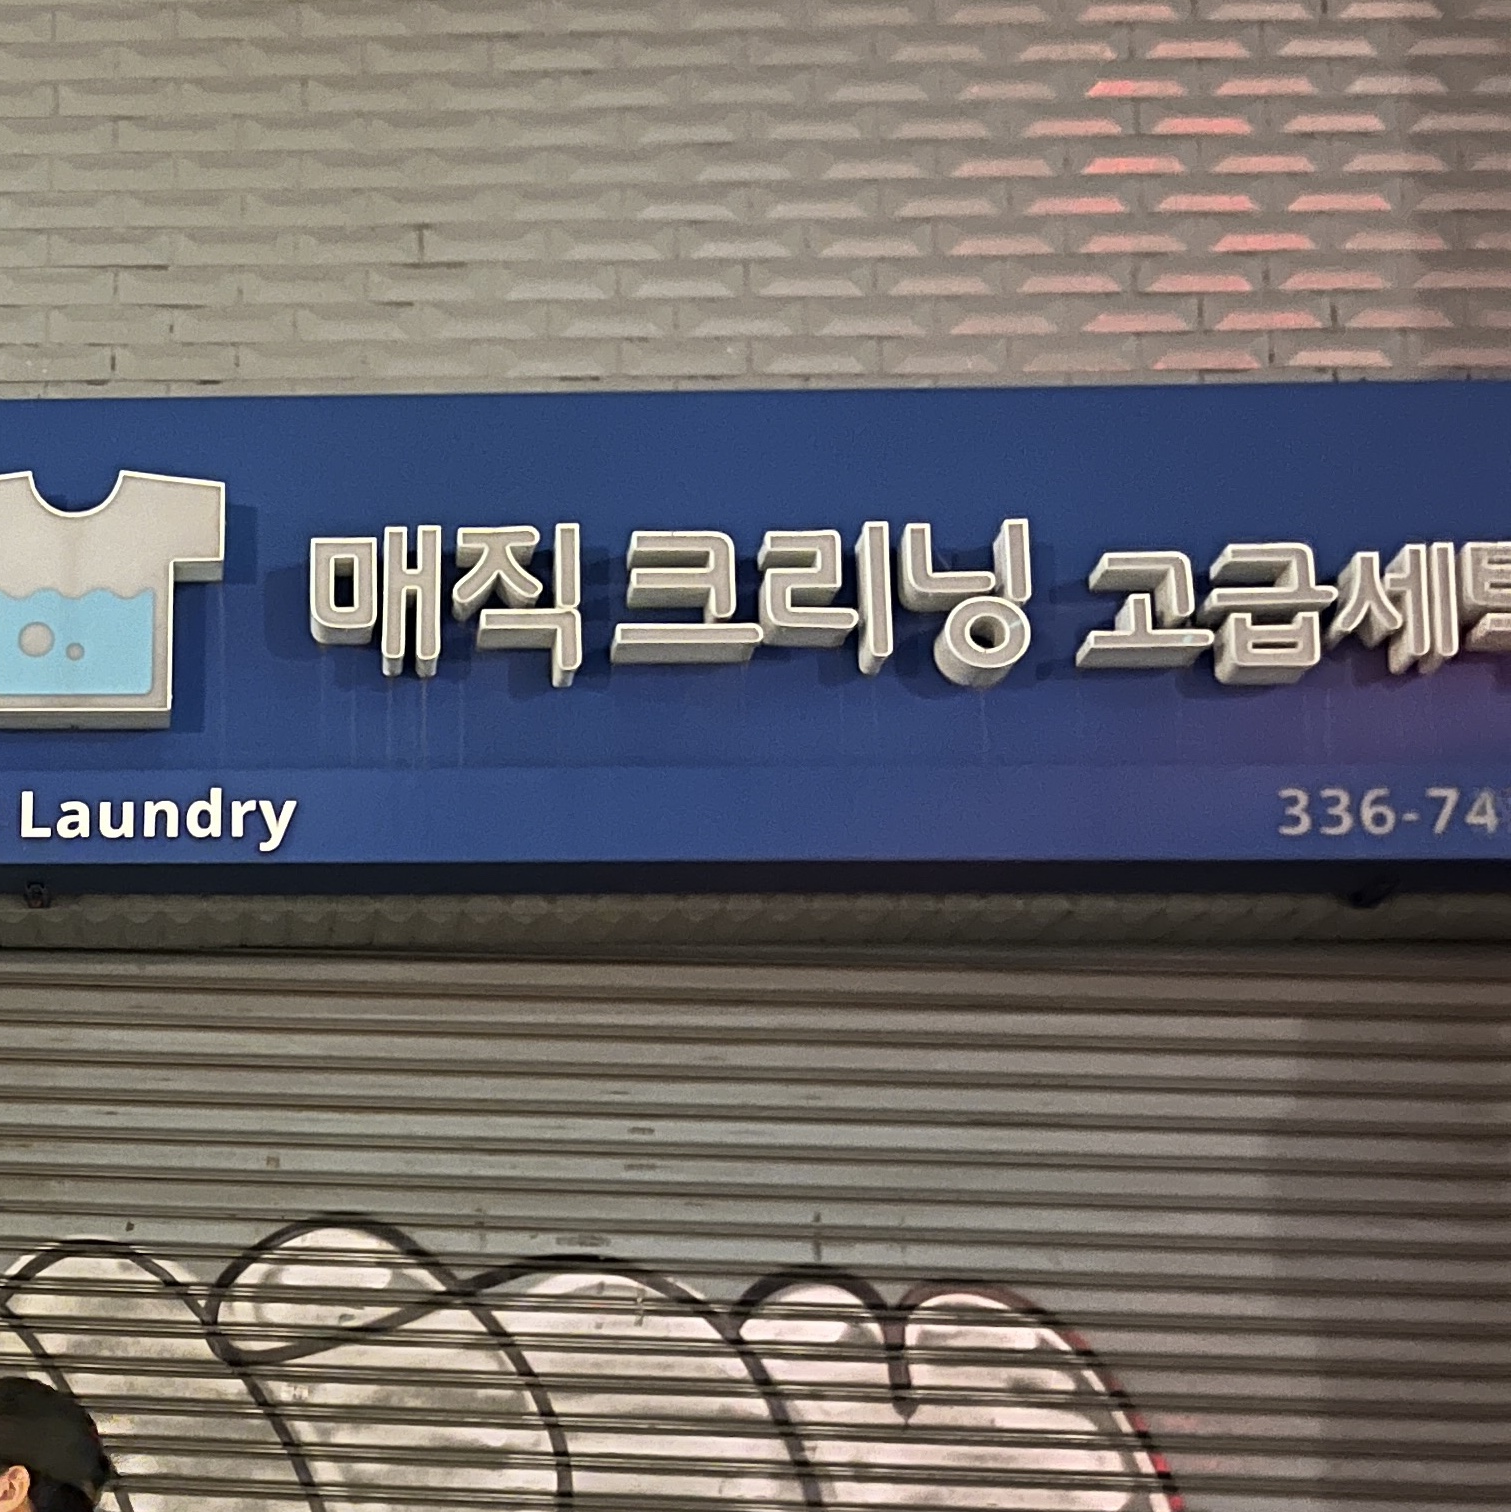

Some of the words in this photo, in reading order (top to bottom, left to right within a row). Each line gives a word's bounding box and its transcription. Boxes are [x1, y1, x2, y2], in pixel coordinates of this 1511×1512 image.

[310, 523, 584, 687] 매직
[610, 518, 1032, 687] 크리닝
[19, 786, 297, 852] Laundry
